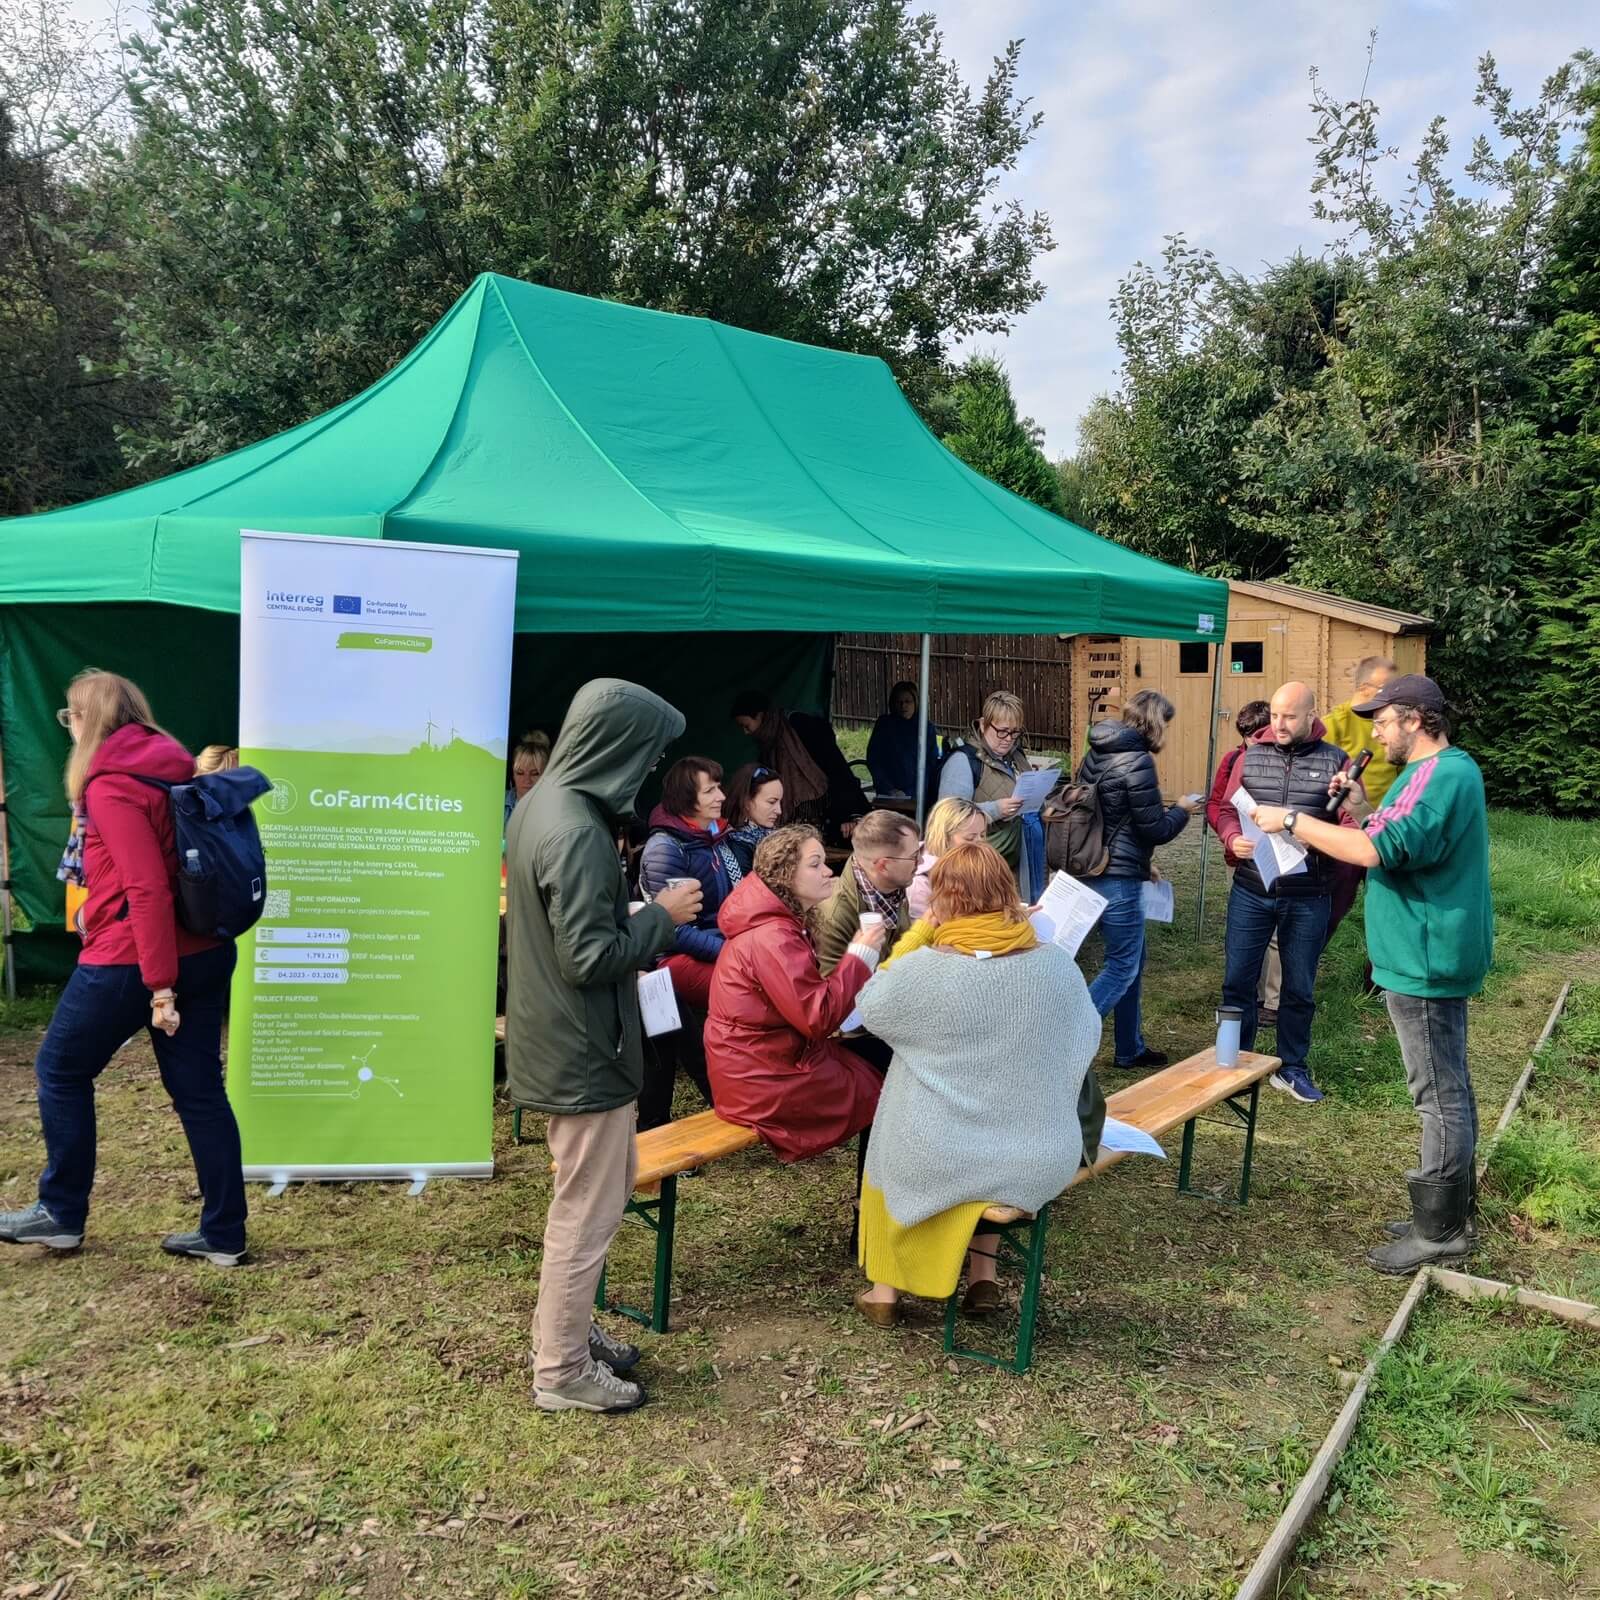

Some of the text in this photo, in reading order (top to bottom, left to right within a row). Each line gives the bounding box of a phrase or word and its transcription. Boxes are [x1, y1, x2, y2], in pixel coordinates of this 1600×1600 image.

[366, 600, 398, 608] Co-funded
[378, 609, 407, 617] European
[374, 637, 426, 648] CoFarm4Cities
[309, 788, 464, 813] CoFarm4Cities
[260, 824, 293, 832] CREATING
[301, 825, 344, 833] SUSTAINABLE
[446, 831, 475, 839] CENTRAL
[309, 833, 344, 841] EFFECTIVE
[338, 843, 380, 851] SUSTAINABLE
[316, 896, 361, 904] INFORMATION
